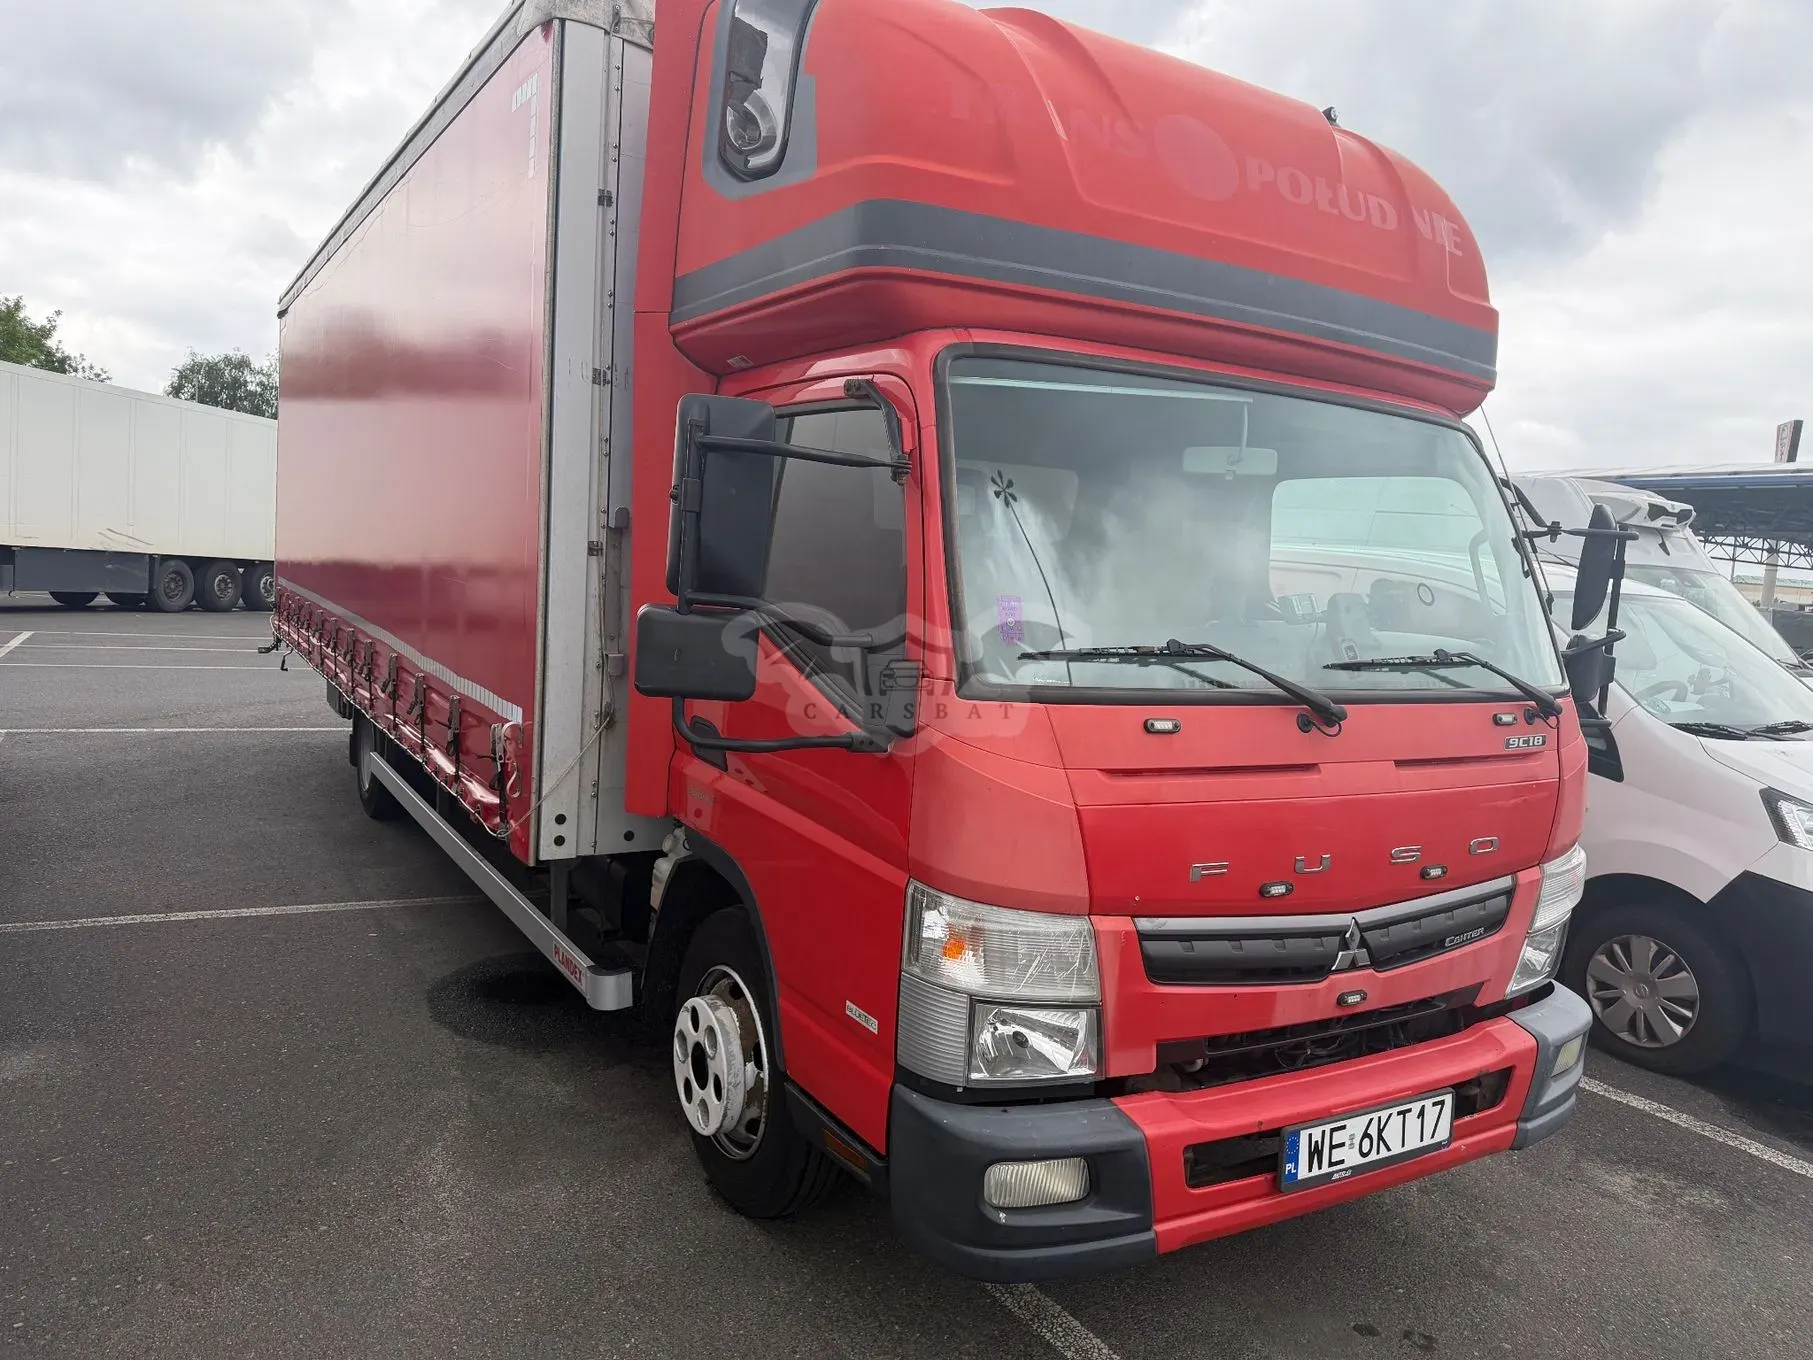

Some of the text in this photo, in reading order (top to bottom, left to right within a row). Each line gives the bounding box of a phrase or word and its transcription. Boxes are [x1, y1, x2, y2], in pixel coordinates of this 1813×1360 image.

[1508, 736, 1543, 748] 9C18
[1190, 837, 1498, 883] FUSO
[553, 943, 583, 986] PLANDEX
[1307, 1099, 1446, 1173] WE 6KT17
[1285, 1162, 1297, 1175] PL
